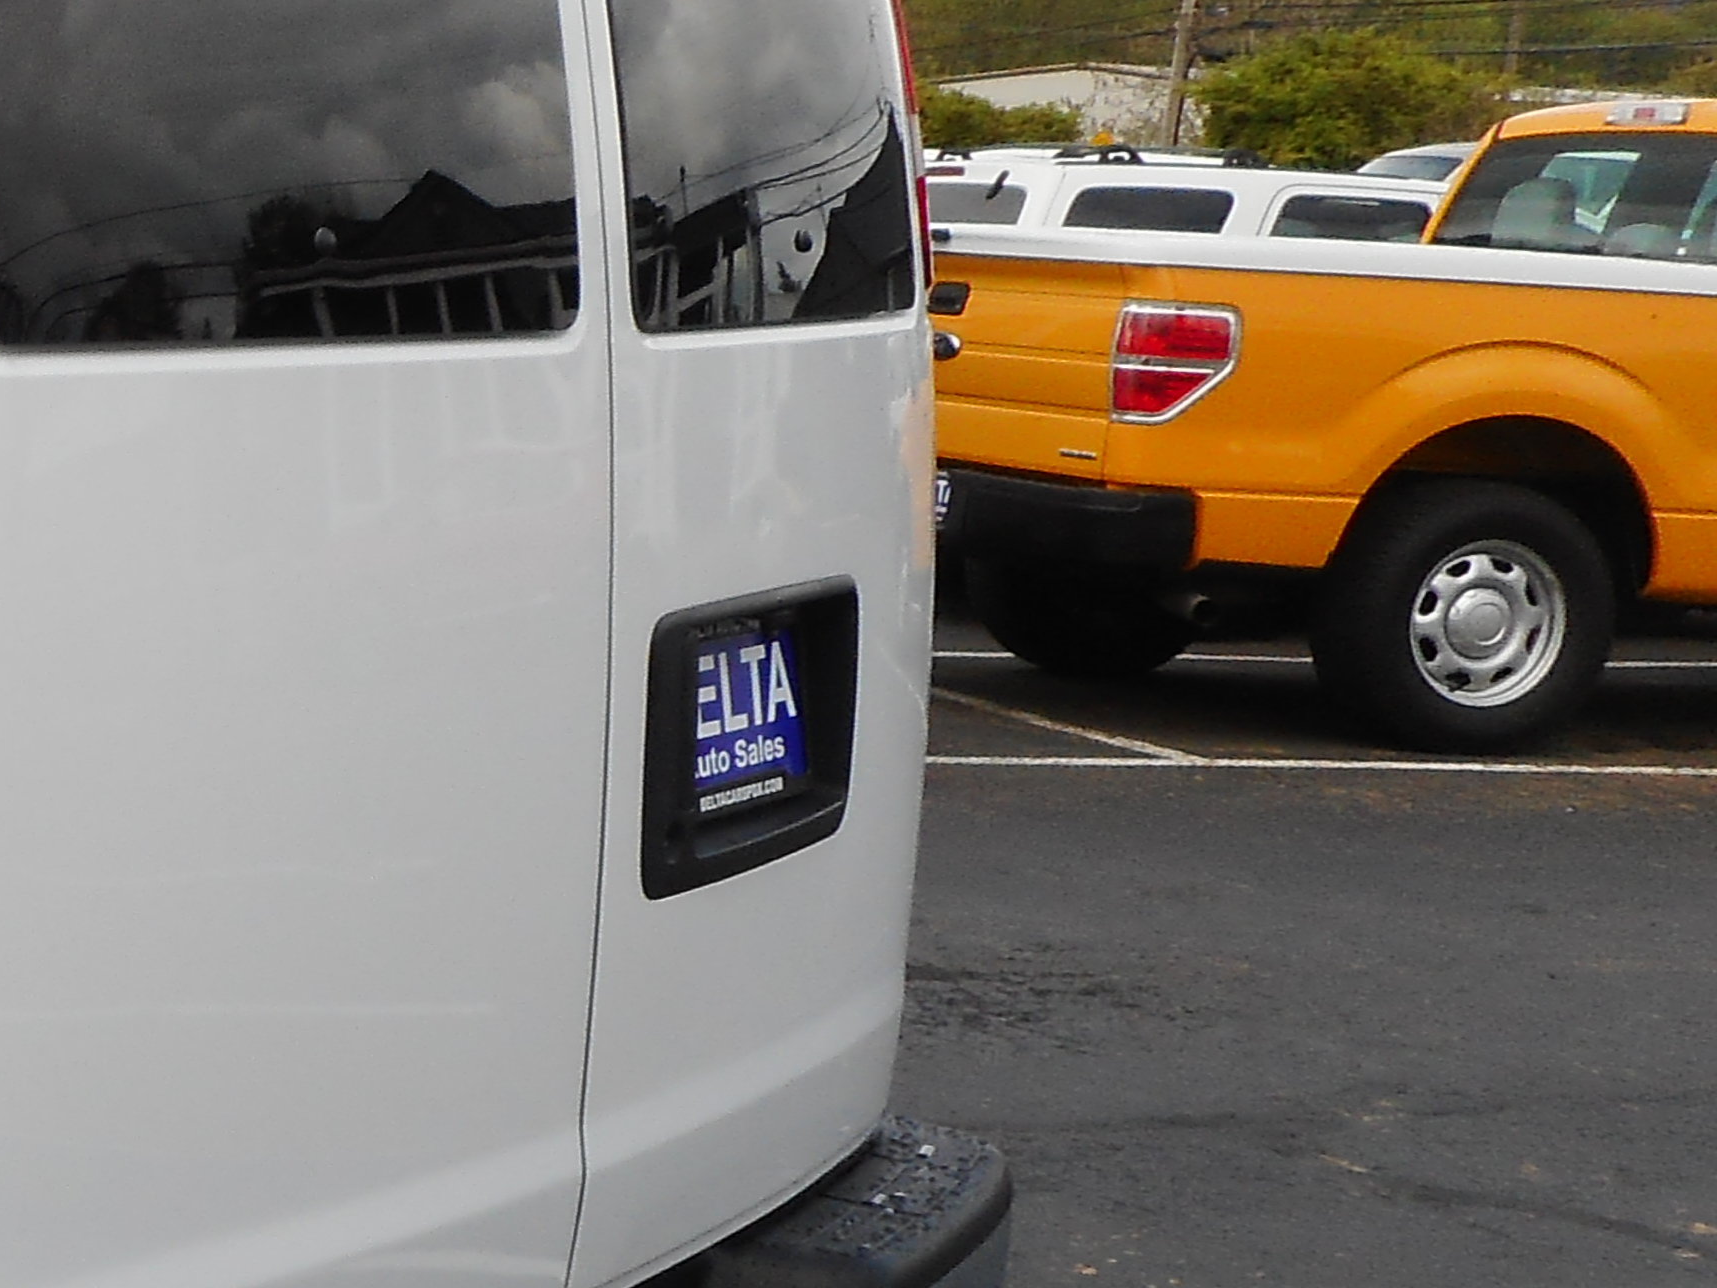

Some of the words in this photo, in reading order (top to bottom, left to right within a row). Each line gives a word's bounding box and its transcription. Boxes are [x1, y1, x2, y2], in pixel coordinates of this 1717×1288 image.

[696, 641, 797, 740] ELTA
[695, 747, 730, 779] uto
[734, 734, 785, 768] Sales
